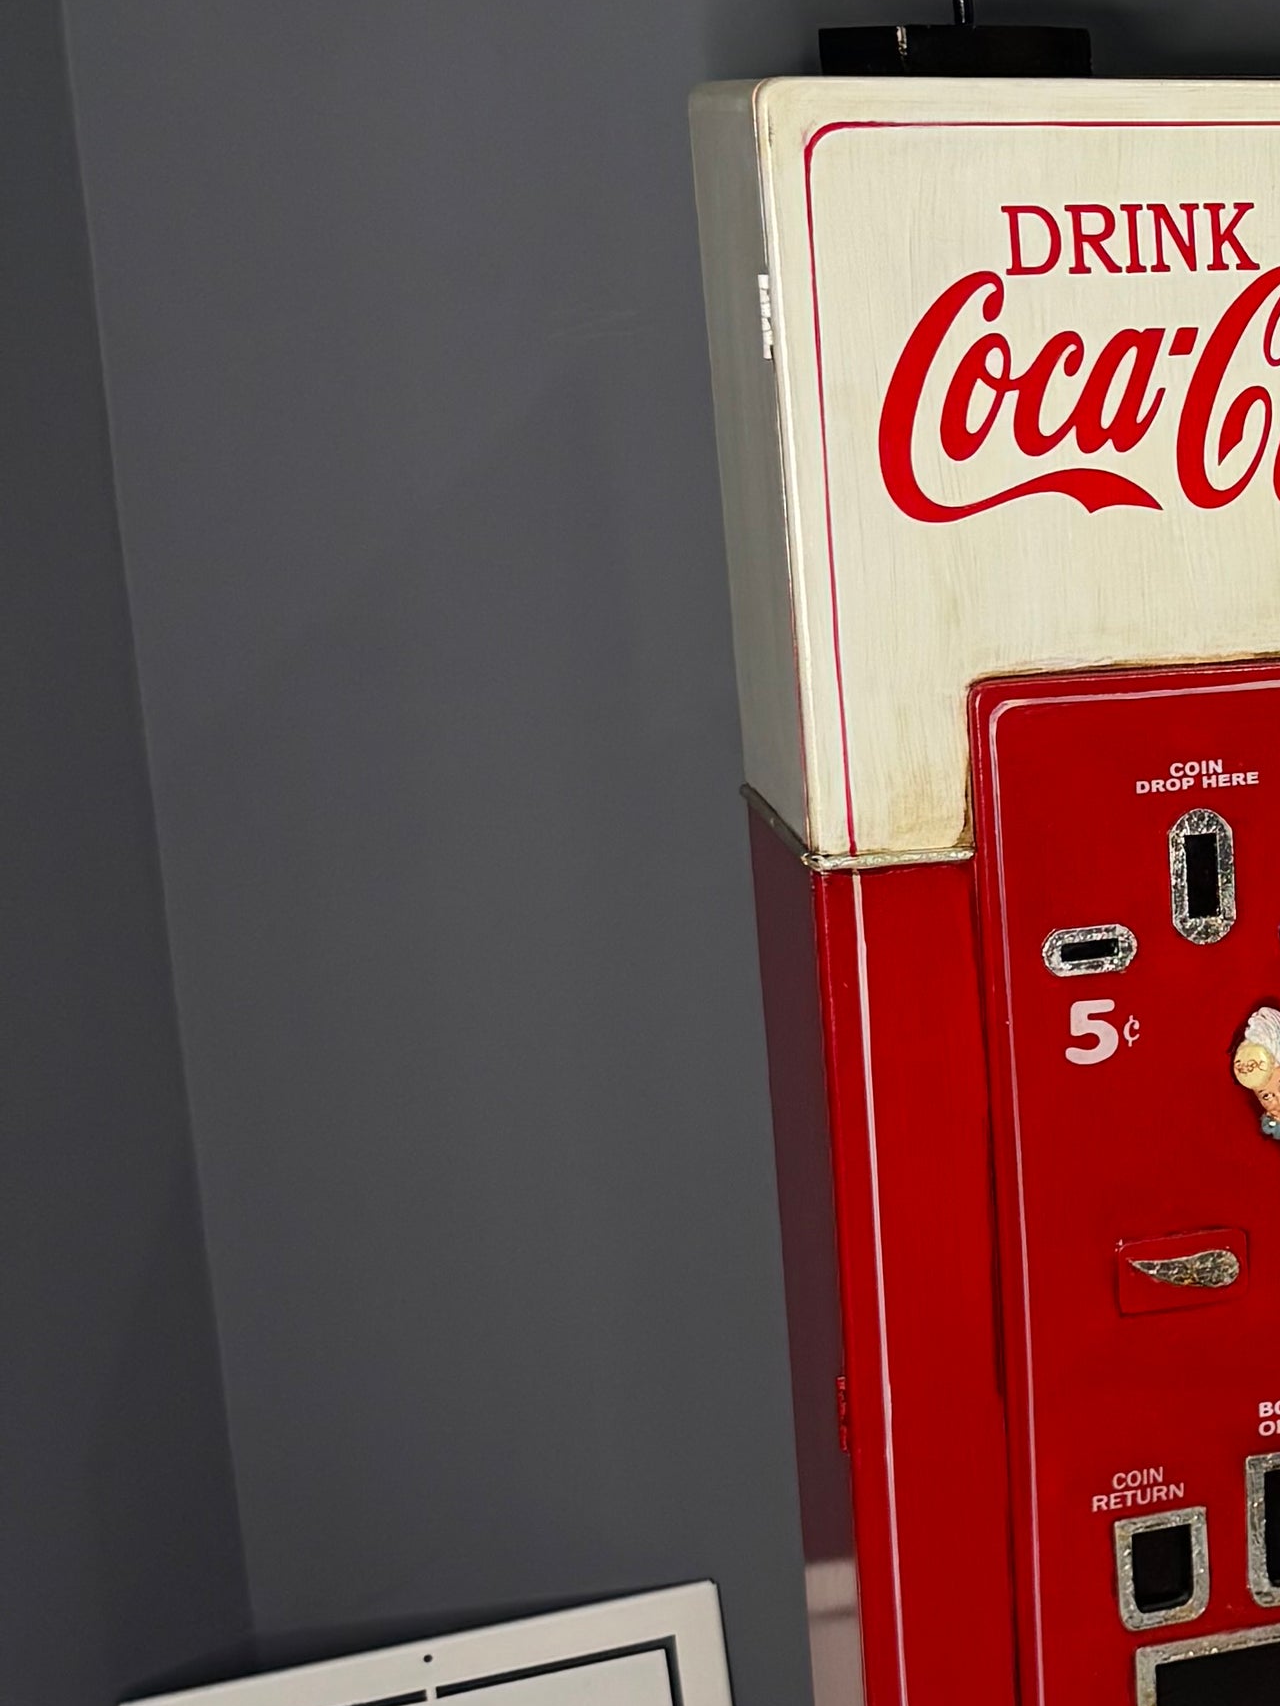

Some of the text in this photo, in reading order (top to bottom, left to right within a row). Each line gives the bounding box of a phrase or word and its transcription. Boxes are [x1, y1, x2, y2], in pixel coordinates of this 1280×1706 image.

[1001, 202, 1260, 276] DRINK
[1169, 759, 1223, 778] COIN
[1135, 770, 1260, 795] DROP HERE
[1112, 1466, 1165, 1492] COIN
[1091, 1482, 1186, 1513] RETURN
